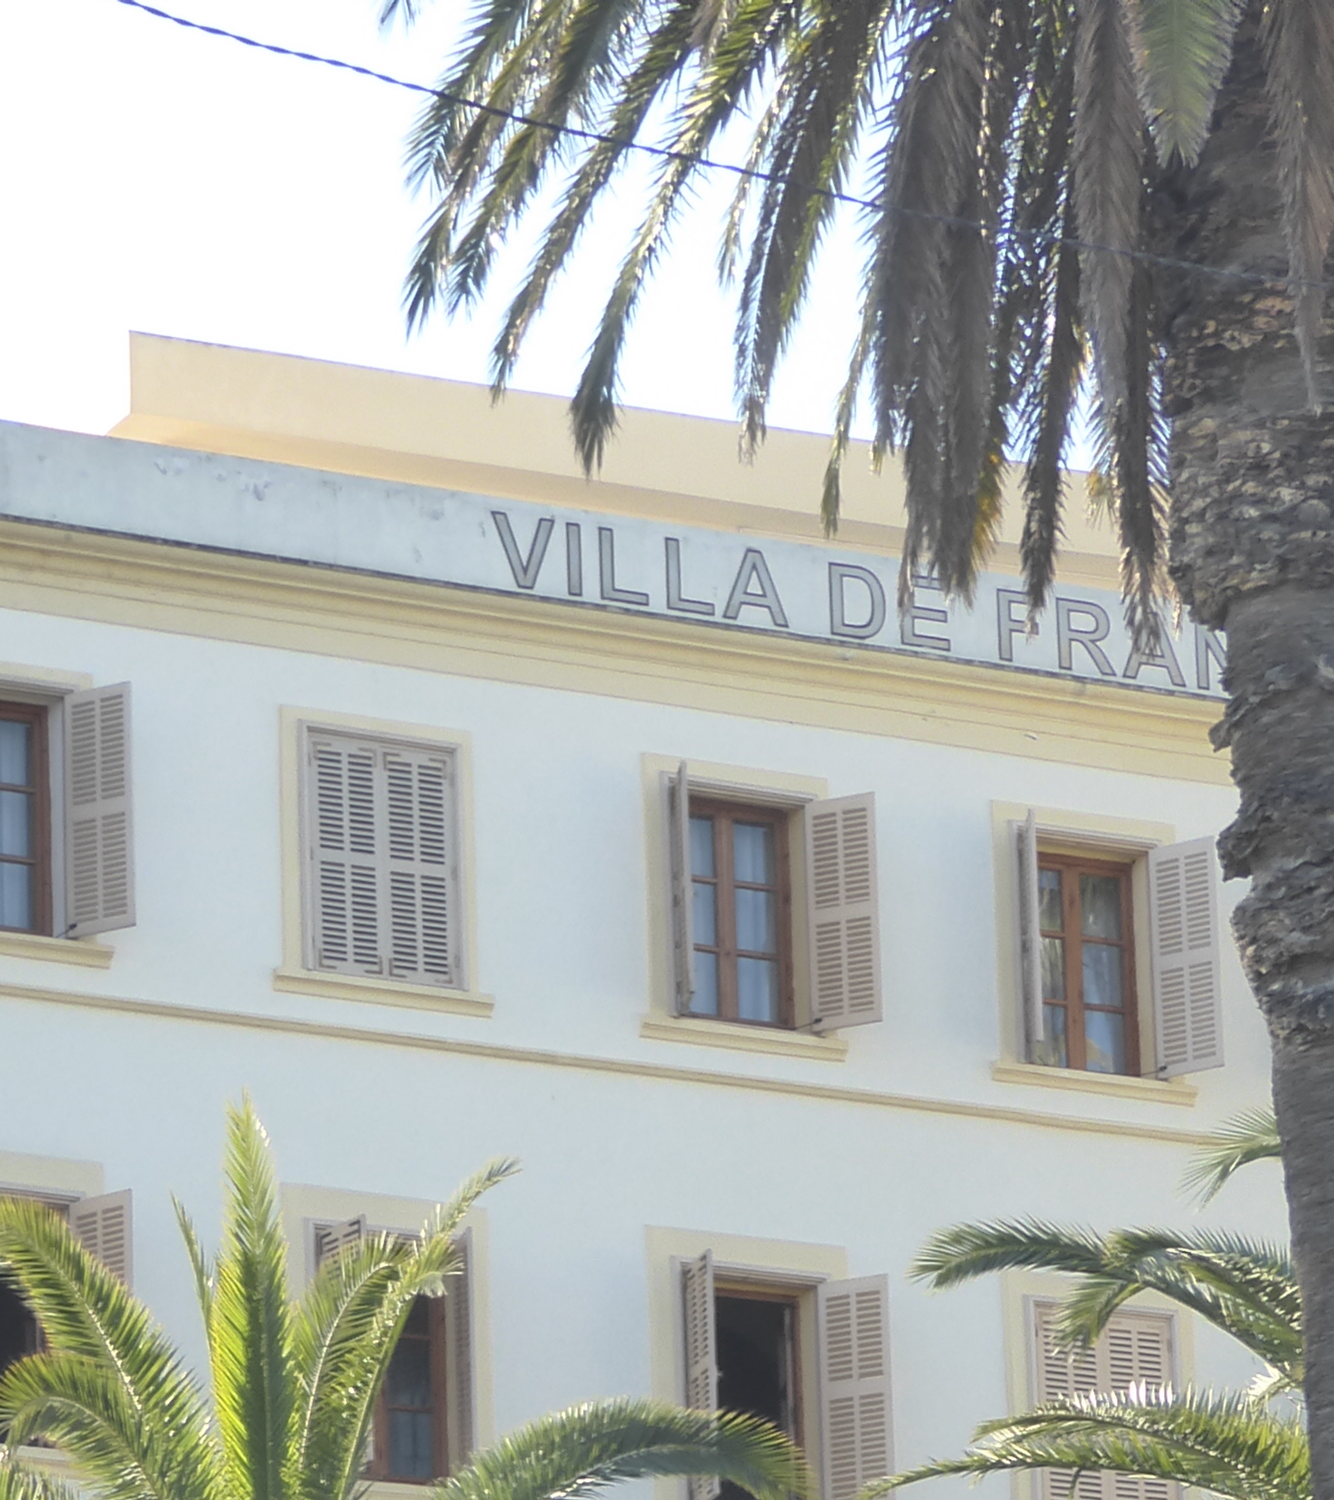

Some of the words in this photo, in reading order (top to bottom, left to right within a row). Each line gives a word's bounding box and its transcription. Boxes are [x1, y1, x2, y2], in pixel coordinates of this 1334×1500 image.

[490, 510, 790, 629] VILLA
[827, 561, 952, 652] DE
[996, 587, 1227, 691] FRAN
